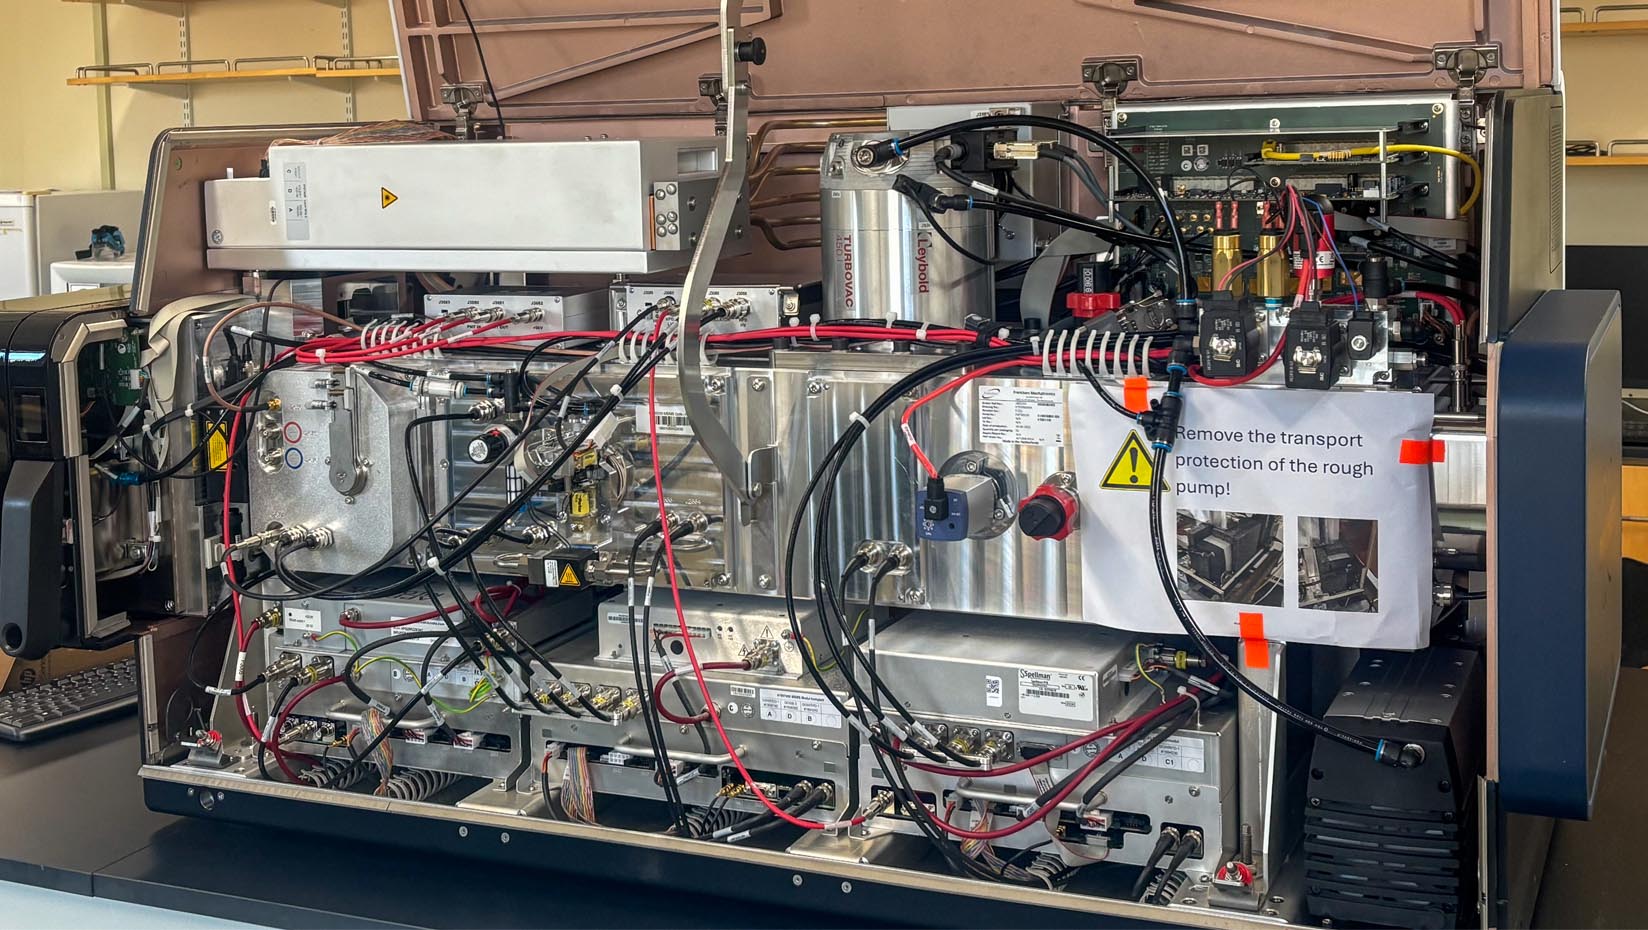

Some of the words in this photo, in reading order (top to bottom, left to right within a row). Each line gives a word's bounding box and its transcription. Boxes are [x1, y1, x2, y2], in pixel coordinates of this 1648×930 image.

[843, 235, 854, 308] TURBOVAC
[915, 239, 930, 293] Leybold
[1176, 425, 1243, 442] Remove
[1248, 427, 1276, 444] the
[1280, 430, 1363, 448] transport
[1176, 454, 1263, 470] protection
[1268, 456, 1286, 472] of
[1289, 457, 1318, 474] the
[1323, 461, 1374, 479] rough
[1176, 481, 1231, 497] pump!
